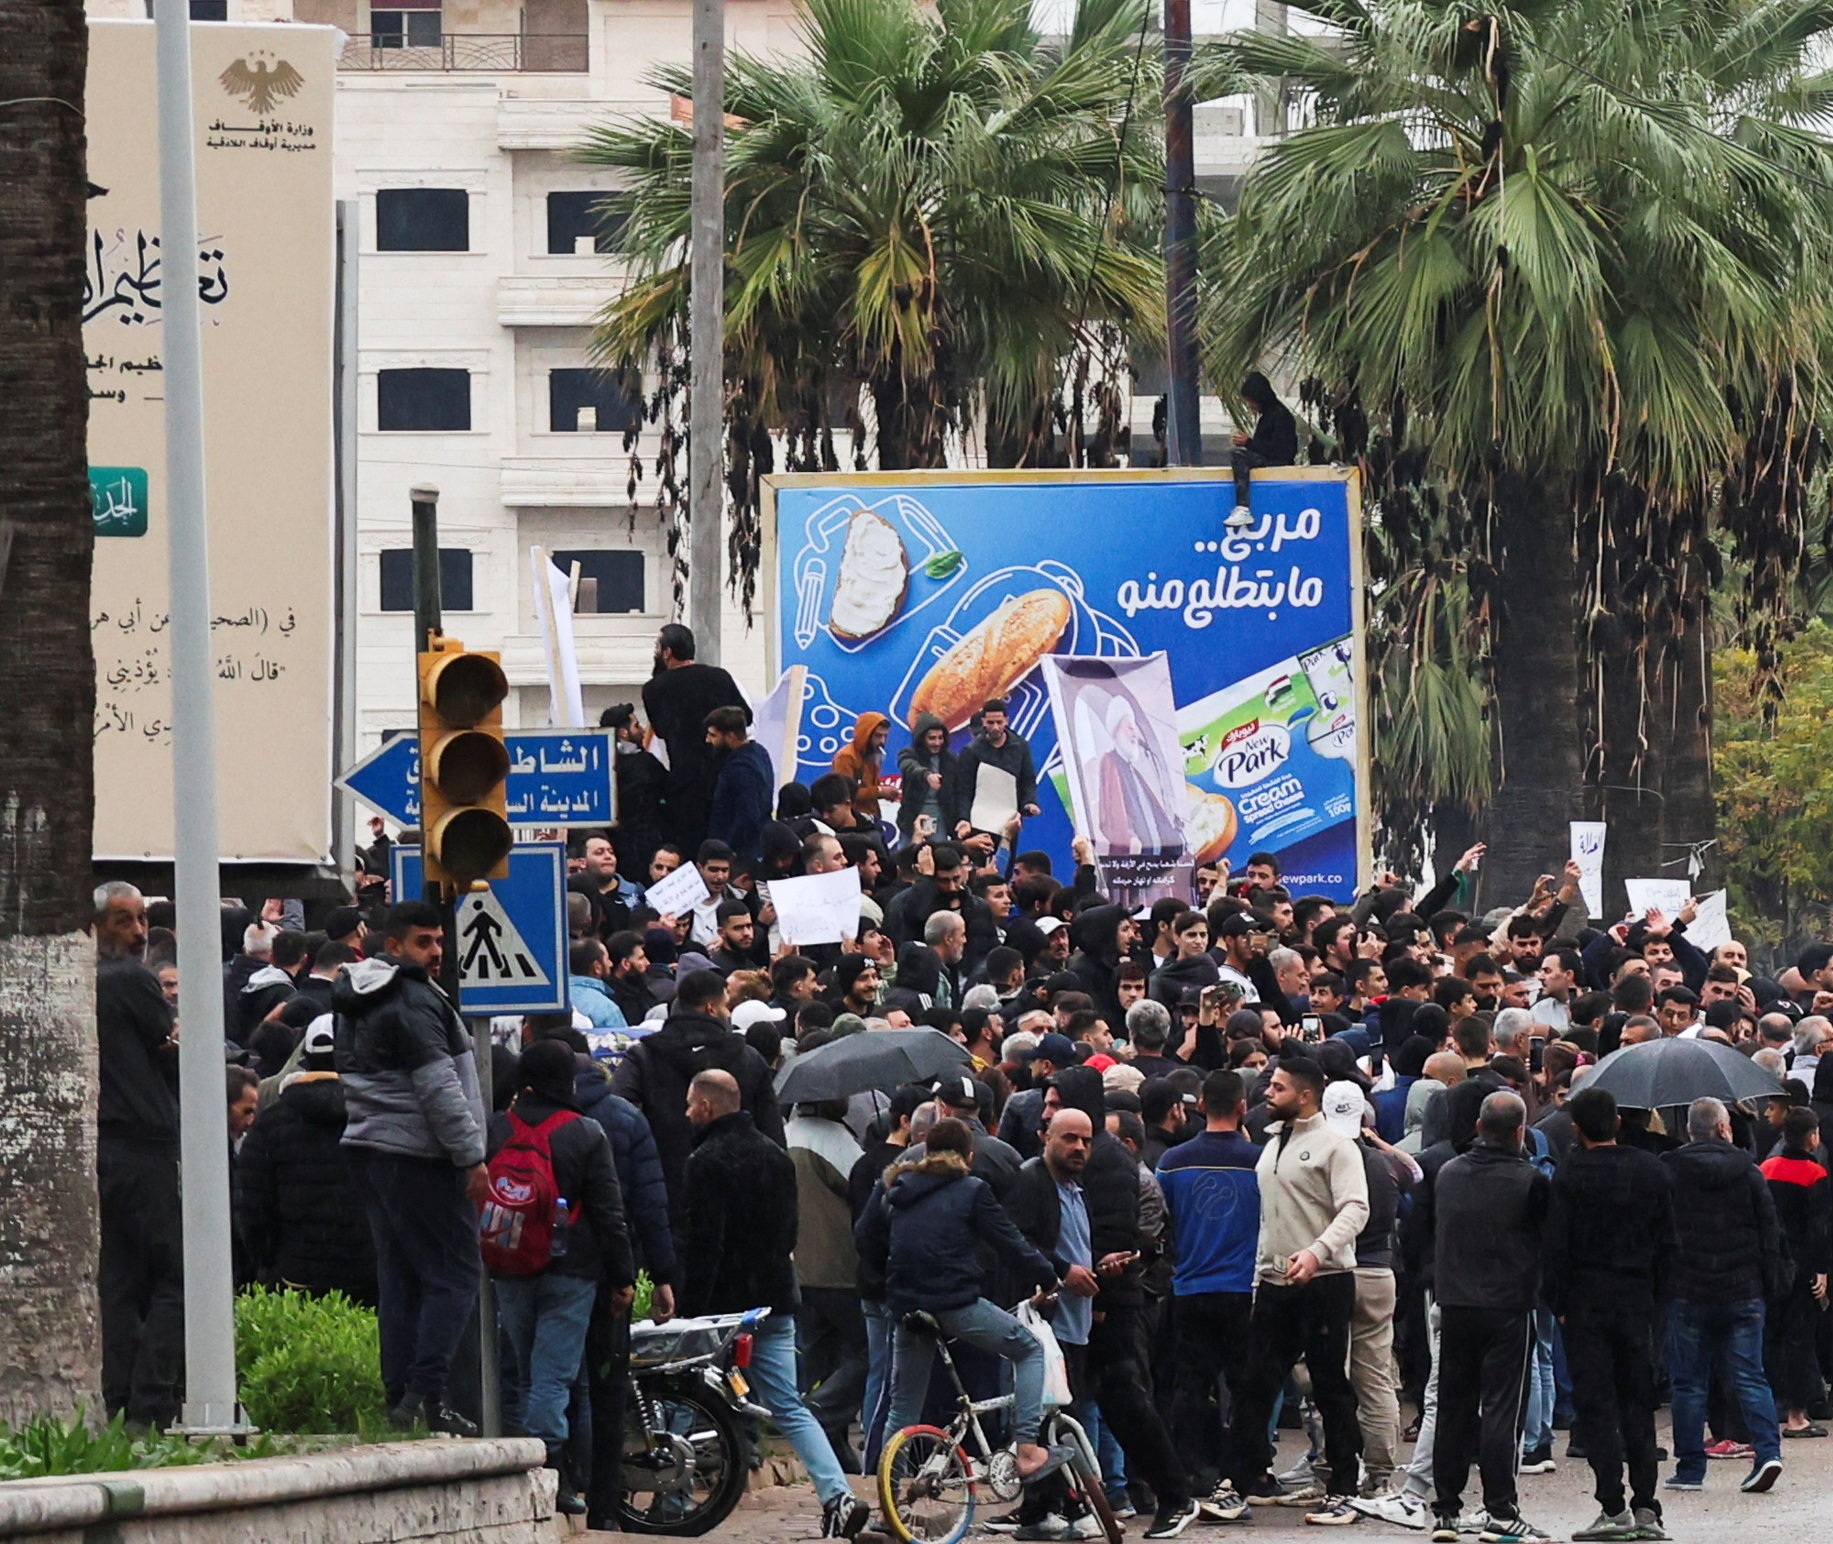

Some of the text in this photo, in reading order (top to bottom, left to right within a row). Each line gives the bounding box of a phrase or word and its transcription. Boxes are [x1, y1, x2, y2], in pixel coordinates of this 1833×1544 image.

[206, 137, 316, 152] مديرية أوقاف اللاذقية
[287, 121, 313, 135] وزارة
[118, 597, 142, 634] أبي
[279, 606, 297, 637] في
[509, 739, 599, 775] الشاط
[1218, 738, 1286, 783] Park
[540, 784, 599, 820] المدينة
